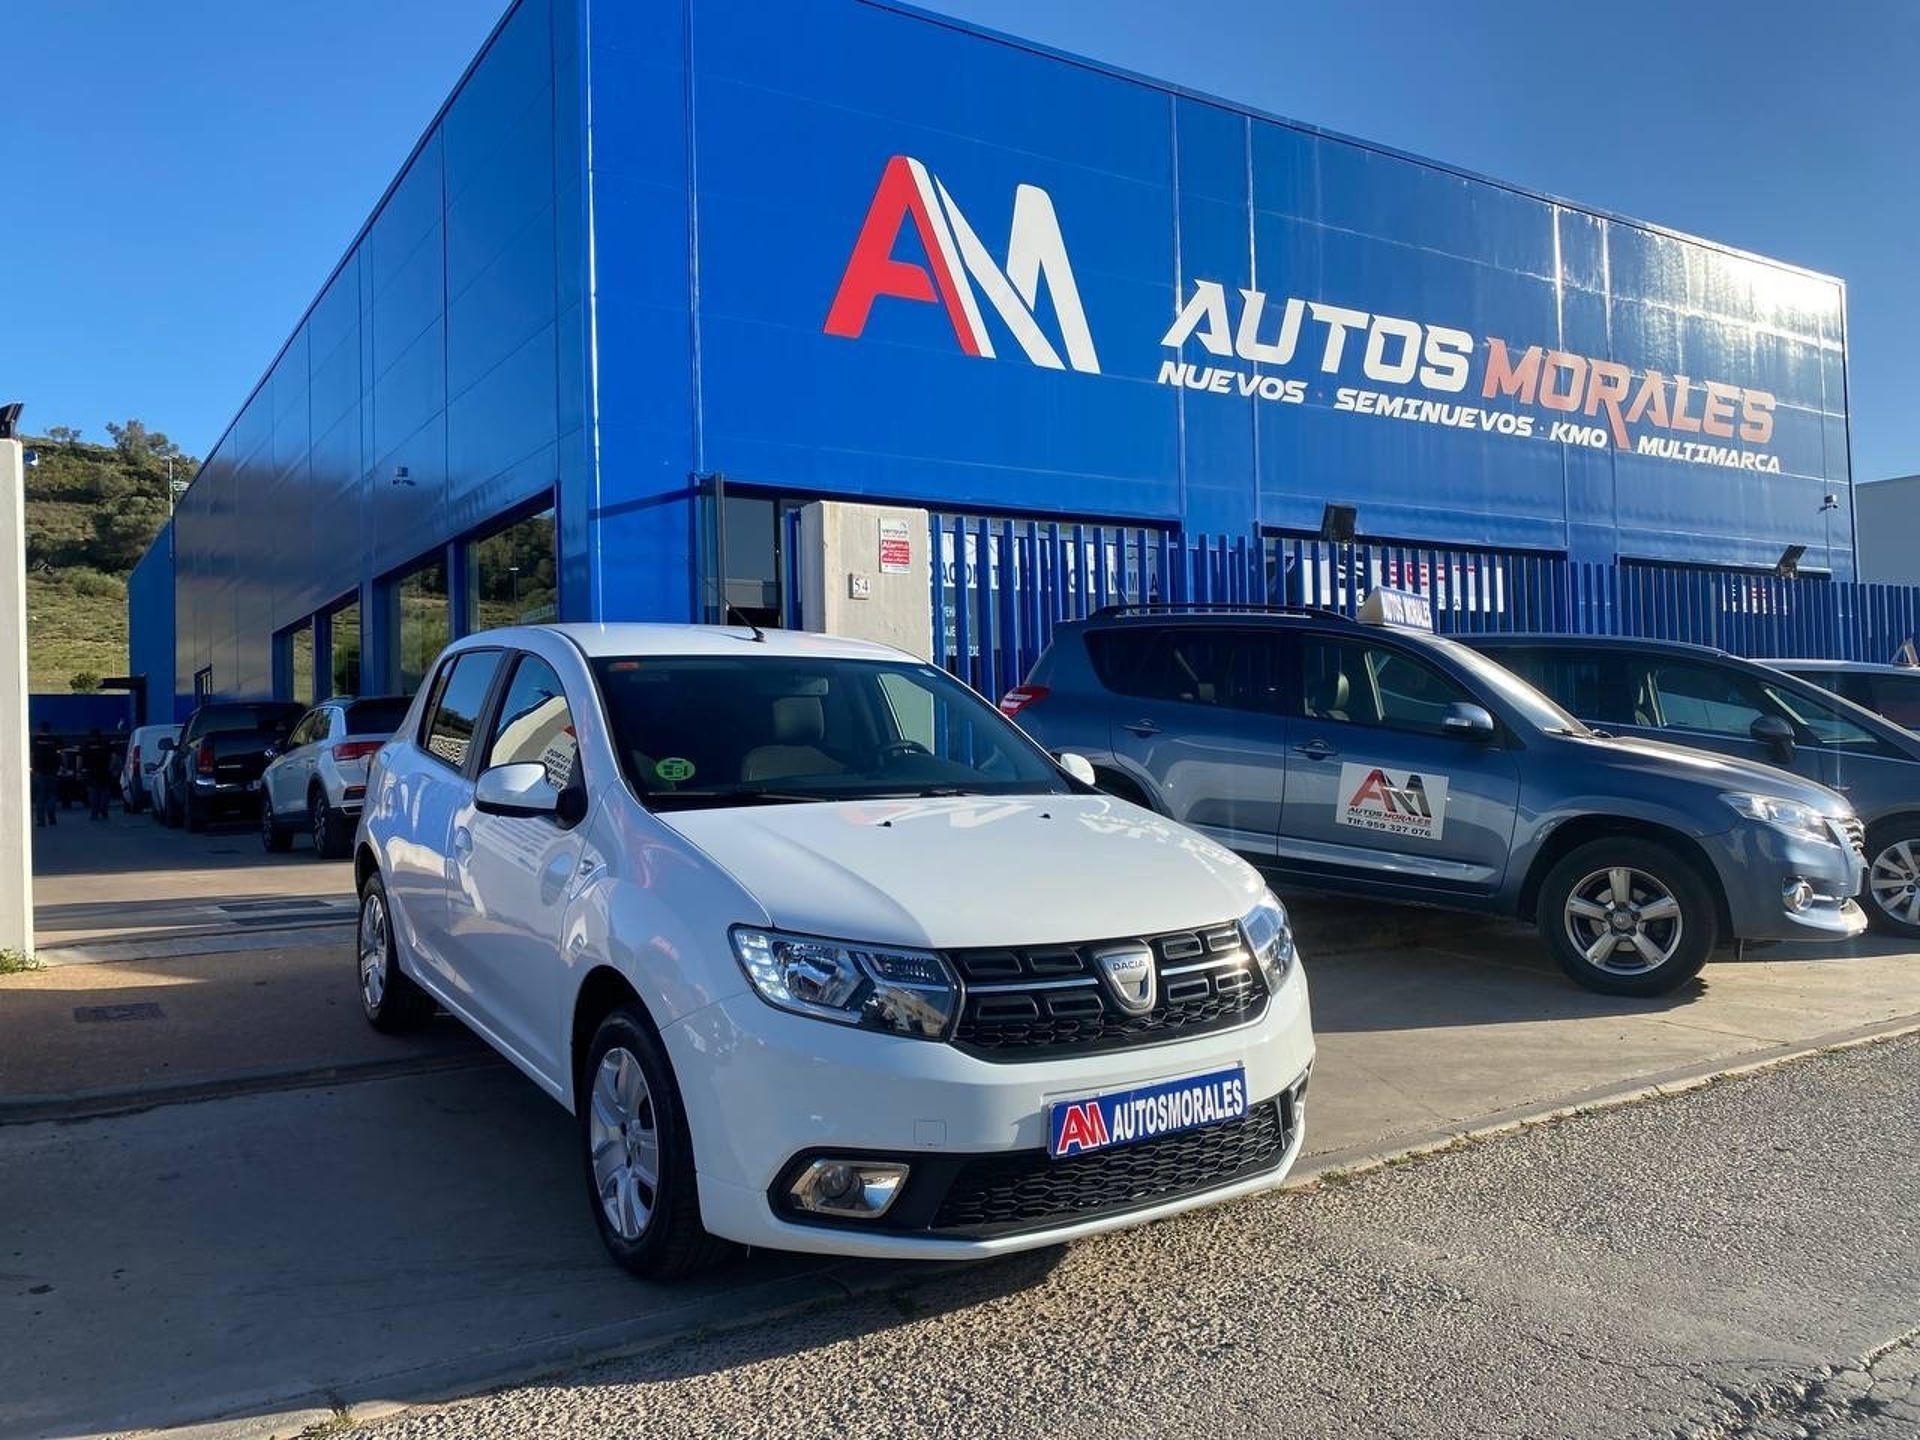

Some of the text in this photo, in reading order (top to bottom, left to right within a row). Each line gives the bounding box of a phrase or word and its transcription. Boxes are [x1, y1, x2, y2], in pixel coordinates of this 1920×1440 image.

[823, 155, 1101, 375] AM
[1160, 278, 1777, 450] AUTOS MORALES
[1157, 360, 1309, 404] NUEVOS
[1334, 387, 1535, 438] SEMINUEVOS
[1637, 435, 1781, 474] MULTIMARCA
[854, 578, 868, 593] 54
[1347, 807, 1431, 825] AUTOS MORALES
[1349, 769, 1432, 818] AM
[1366, 820, 1386, 830] 959
[1390, 823, 1408, 833] 327
[1113, 960, 1145, 970] DACIA
[1056, 1079, 1244, 1155] AM AUTOSMORALES
